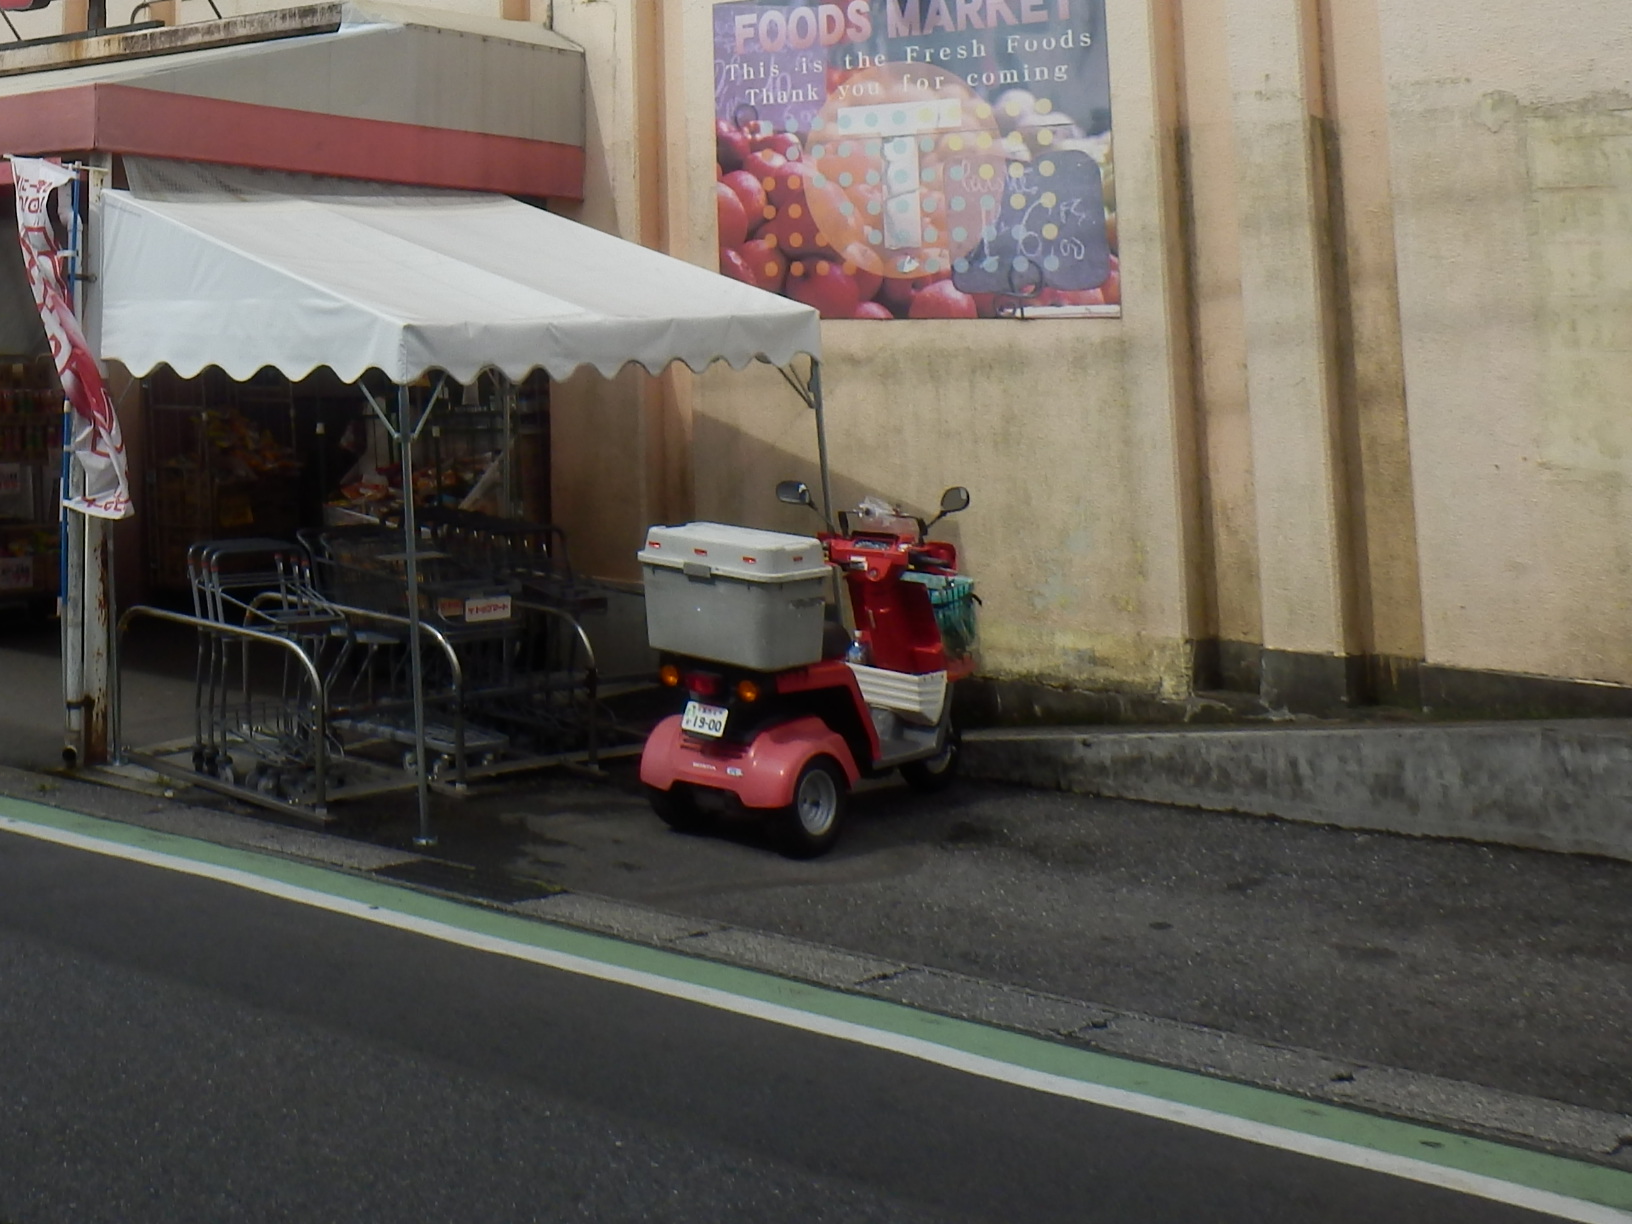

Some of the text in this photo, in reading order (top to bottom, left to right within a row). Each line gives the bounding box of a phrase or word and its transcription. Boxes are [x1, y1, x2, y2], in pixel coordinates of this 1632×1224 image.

[726, 29, 1092, 81] This is the Fresh Foods
[745, 64, 1069, 106] Thank you for coming
[693, 715, 722, 733] 19-00
